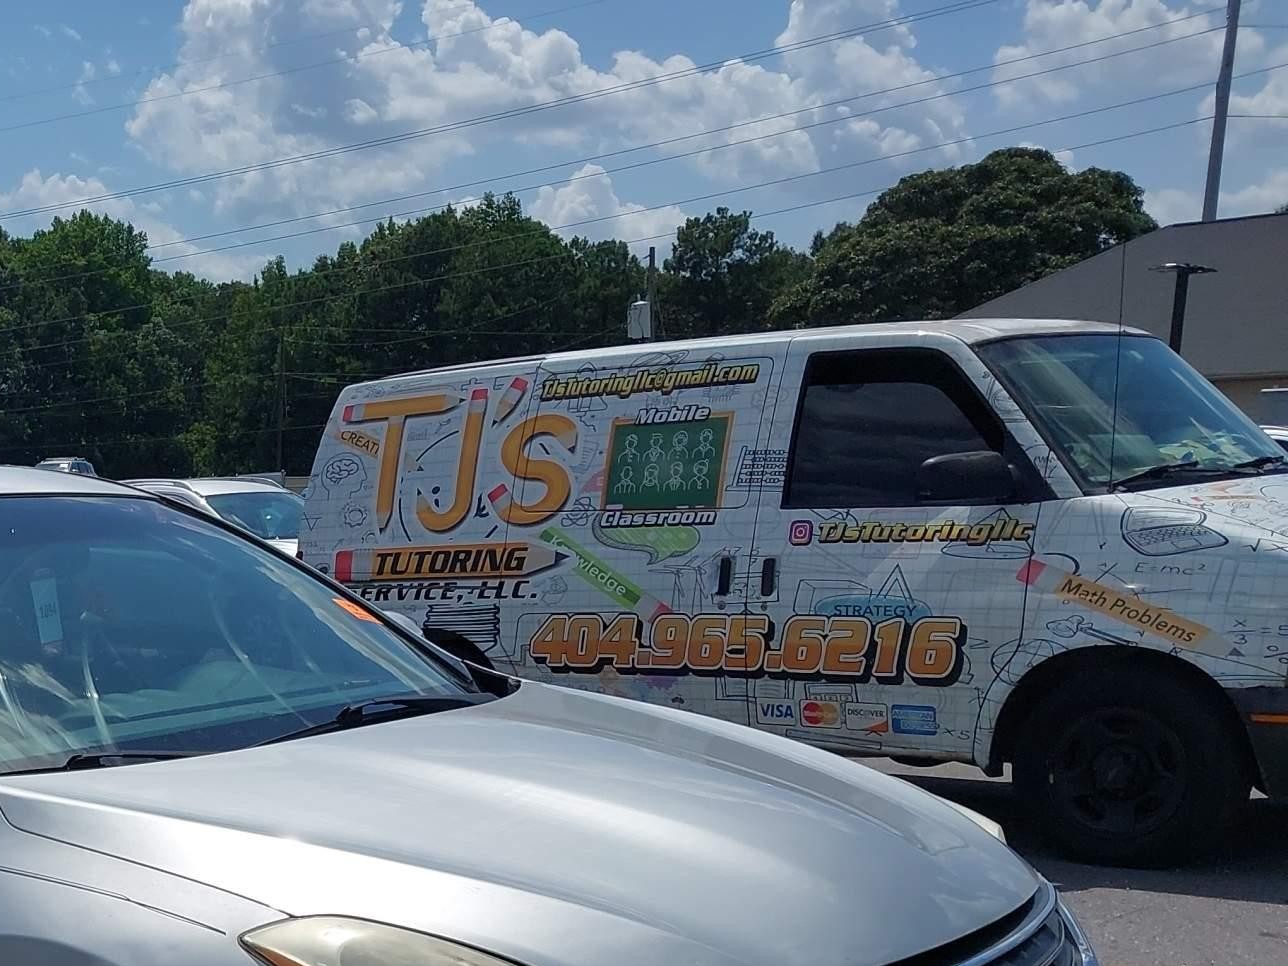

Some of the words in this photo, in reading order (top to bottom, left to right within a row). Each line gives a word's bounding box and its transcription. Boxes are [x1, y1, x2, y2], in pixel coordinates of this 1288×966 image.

[634, 405, 711, 426] Mobile
[600, 510, 717, 528] Classroom
[376, 547, 528, 576] TUTORING
[550, 535, 626, 596] Kwledge
[346, 580, 464, 603] ERVICE,
[477, 579, 538, 600] LLC.
[833, 603, 917, 617] STRATEGY
[1062, 578, 1107, 607] Math
[1109, 597, 1196, 643] Problems
[530, 613, 964, 684] 404.965.6216
[761, 703, 794, 719] VISA
